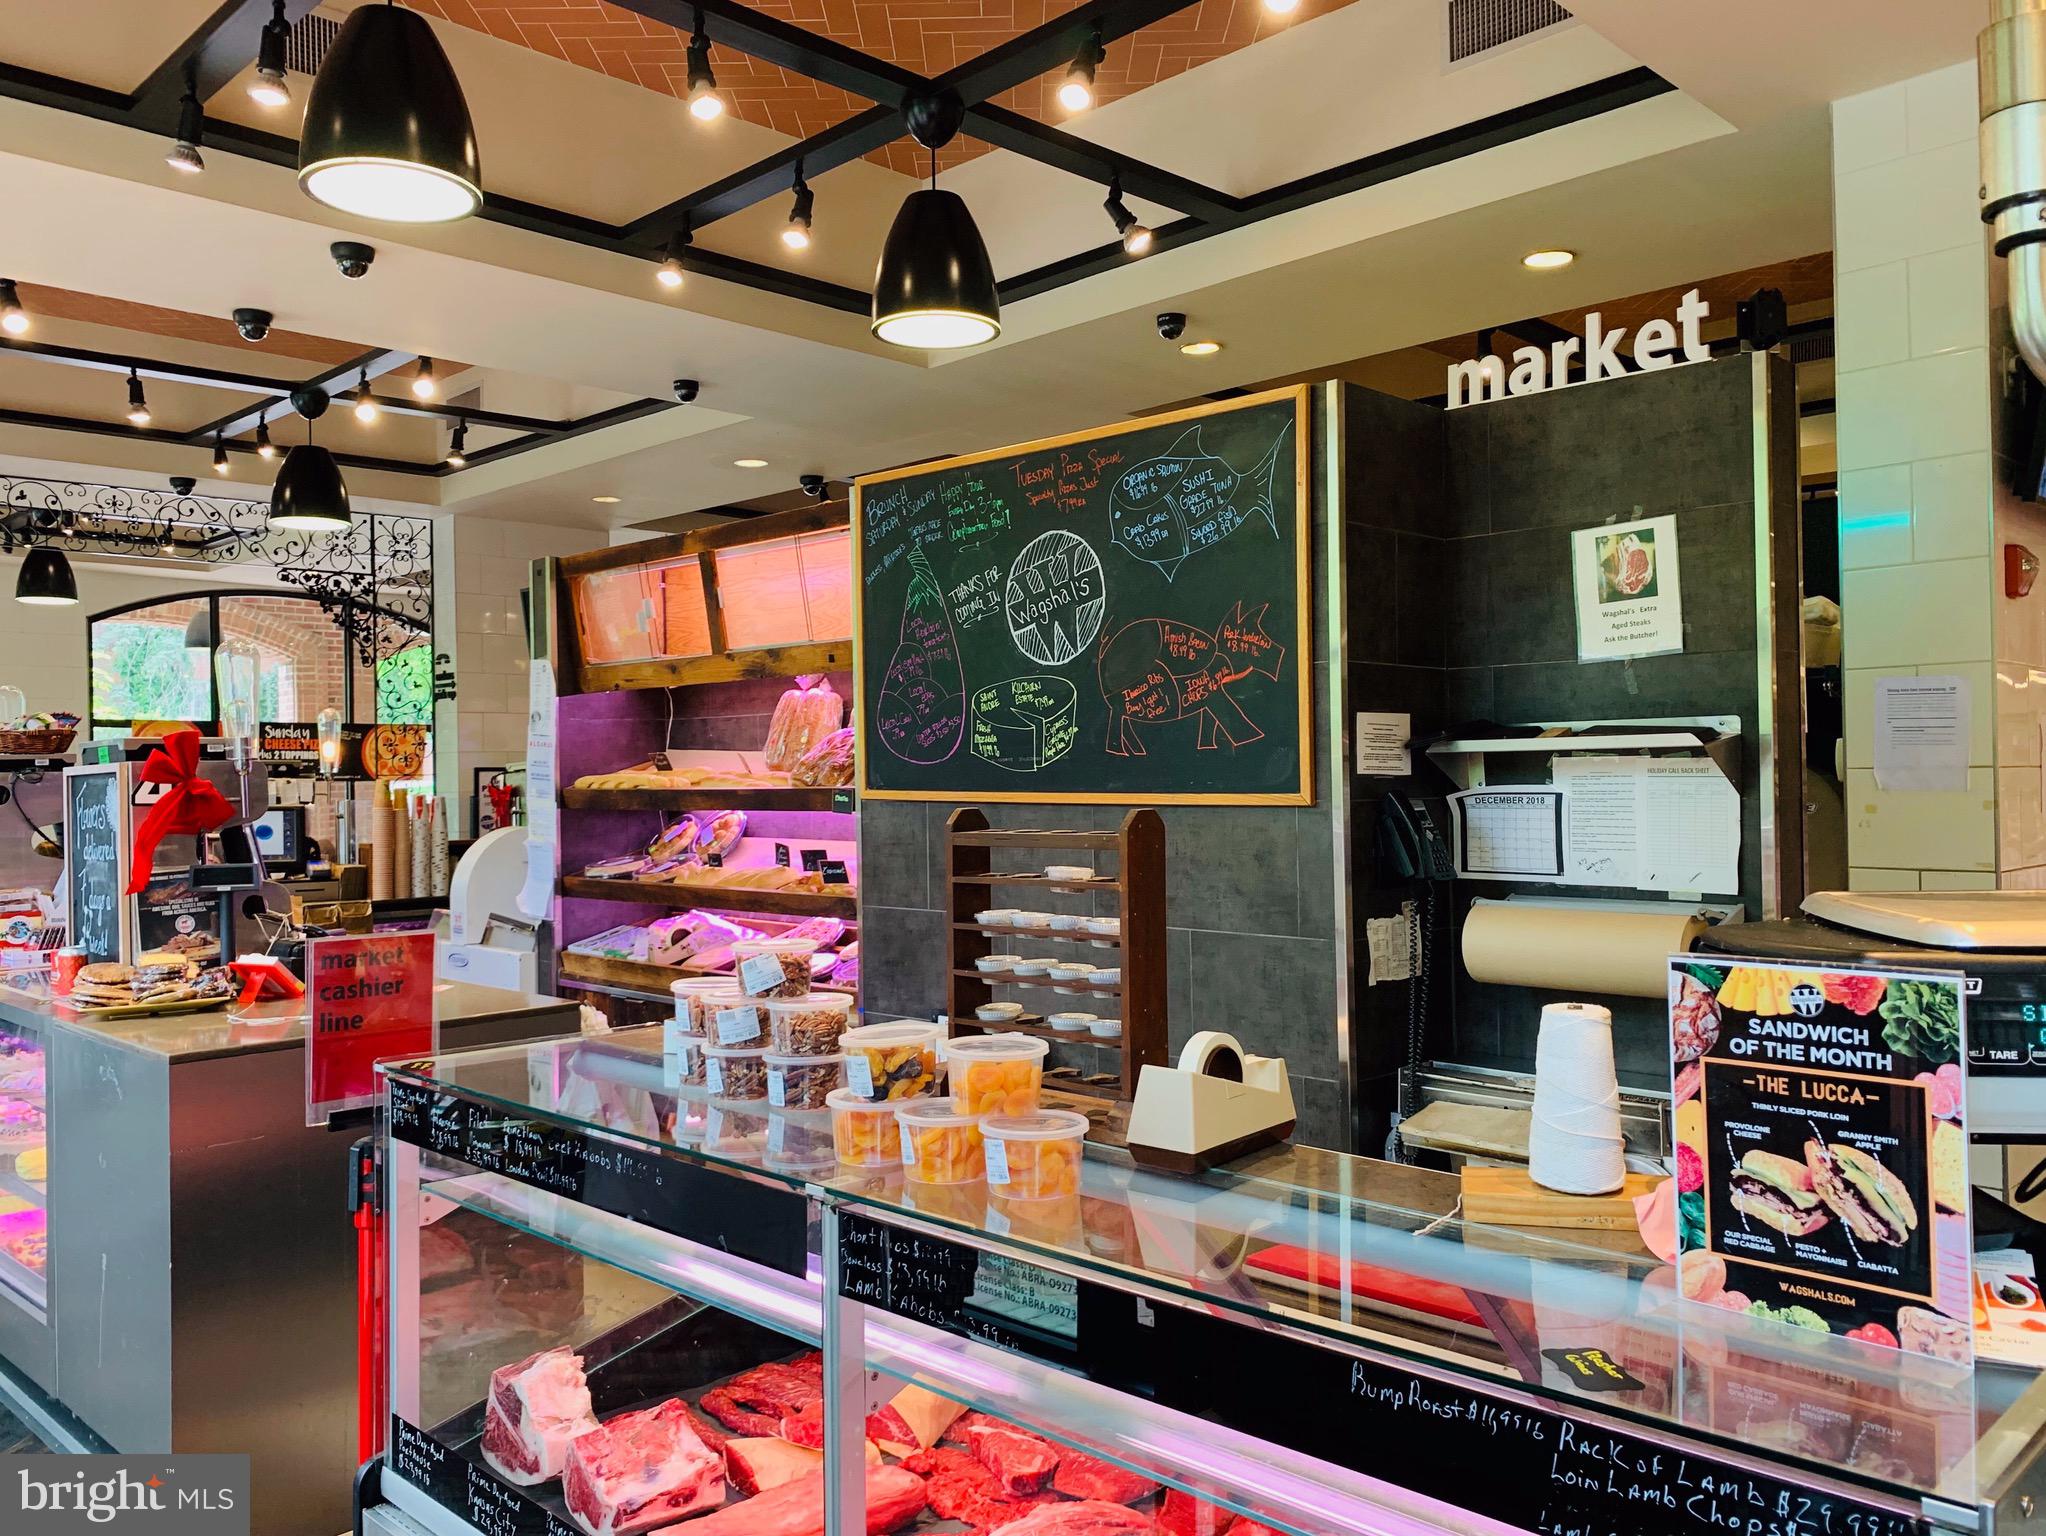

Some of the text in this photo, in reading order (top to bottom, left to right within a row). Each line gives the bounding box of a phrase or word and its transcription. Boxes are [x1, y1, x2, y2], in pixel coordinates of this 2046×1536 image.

[1447, 288, 1710, 409] market
[1182, 468, 1215, 492] SUSHI
[1210, 476, 1234, 494] TUNA
[948, 565, 1004, 605] THANKS FOR
[1009, 577, 1091, 625] Wagshal's
[1602, 605, 1658, 619] Wagshal's Extra
[1611, 618, 1651, 630] Aged Steaks
[1617, 634, 1628, 642] the
[1629, 630, 1659, 641] Butcher!
[264, 724, 311, 742] Sunday
[265, 738, 301, 750] CHEESE
[274, 750, 280, 760] 2
[281, 750, 319, 760] TOPPINGS
[1647, 767, 1667, 775] HOLIDAY
[1667, 767, 1680, 775] CALL
[1680, 767, 1694, 775] BACK
[1475, 796, 1546, 805] DECEMBER 2018
[83, 832, 115, 862] delivered
[320, 947, 405, 970] market
[319, 977, 405, 1001] cashier
[319, 1012, 365, 1033] line
[1748, 1018, 1870, 1047] SANDWICH
[1729, 1038, 1893, 1072] OF THE MONTH
[1989, 1050, 2019, 1060] TARE
[1751, 1101, 1850, 1122] THINLY SLICED PORK LOIN
[1724, 1120, 1771, 1134] PROVOLONE
[1732, 1129, 1762, 1140] CHEESE
[1837, 1130, 1899, 1146] GRANNY SMITH
[1854, 1140, 1882, 1151] APPLE
[1723, 1237, 1776, 1254] RED CABBAGE
[1724, 1230, 1773, 1246] OUR SPECIAL
[1795, 1242, 1822, 1254] PESTO
[1857, 1260, 1900, 1275] CIABATTA
[974, 1272, 1003, 1287] icense
[1029, 1286, 1035, 1297] B
[974, 1283, 1003, 1299] icense
[1021, 1296, 1077, 1320] ABRA-09273
[1779, 1281, 1856, 1307] WAGSHALS.COM
[1351, 1361, 1404, 1407] Rump
[495, 1507, 517, 1536] City
